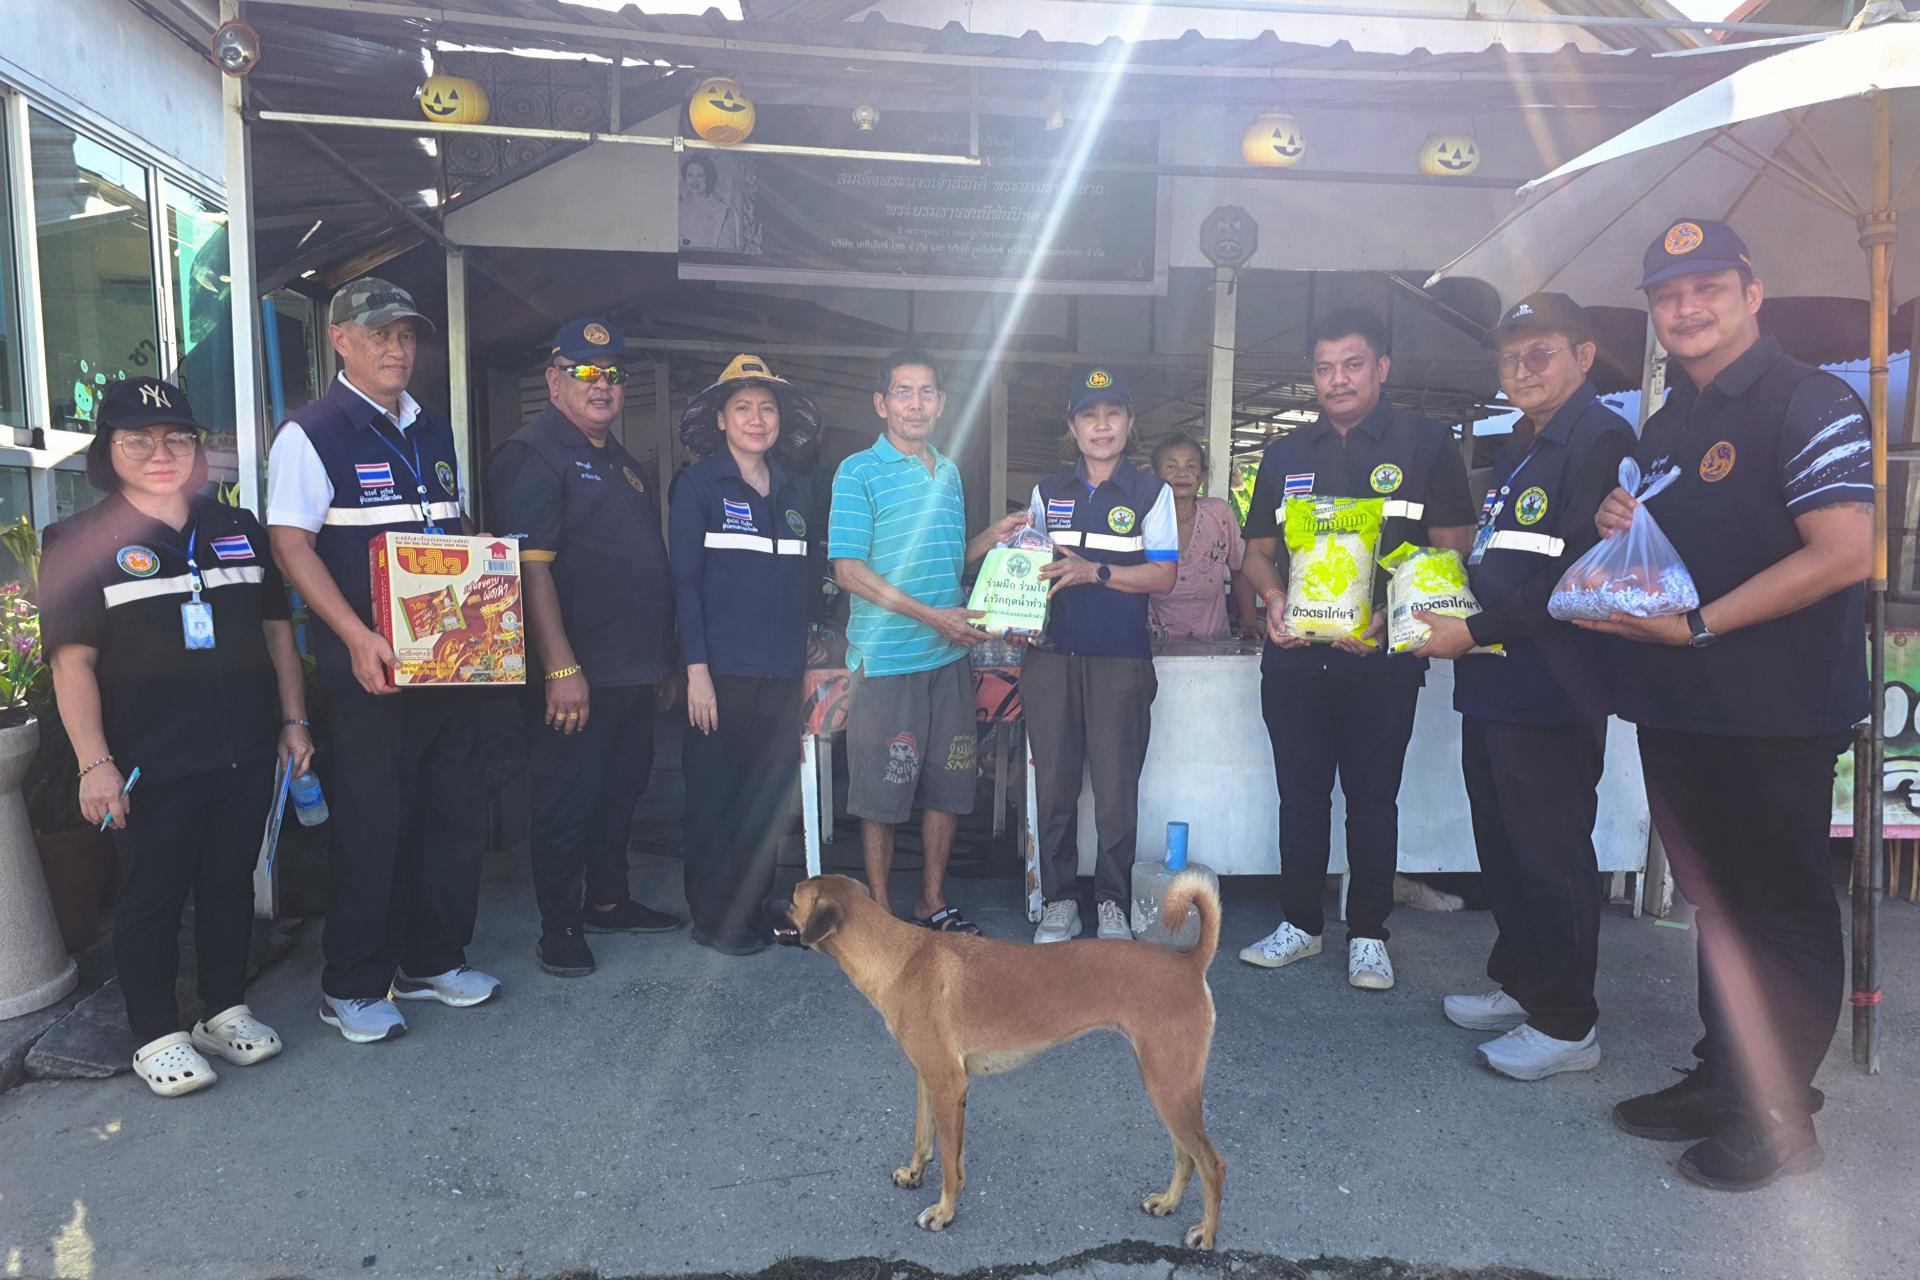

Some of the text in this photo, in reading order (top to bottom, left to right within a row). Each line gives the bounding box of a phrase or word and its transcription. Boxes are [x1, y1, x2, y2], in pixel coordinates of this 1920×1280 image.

[138, 384, 172, 408] NY
[398, 548, 462, 575] ไวไว
[986, 577, 1047, 593] ร่วมมือ ร่วมใจ
[1292, 605, 1354, 621] ข้าวตราไก่แจ้
